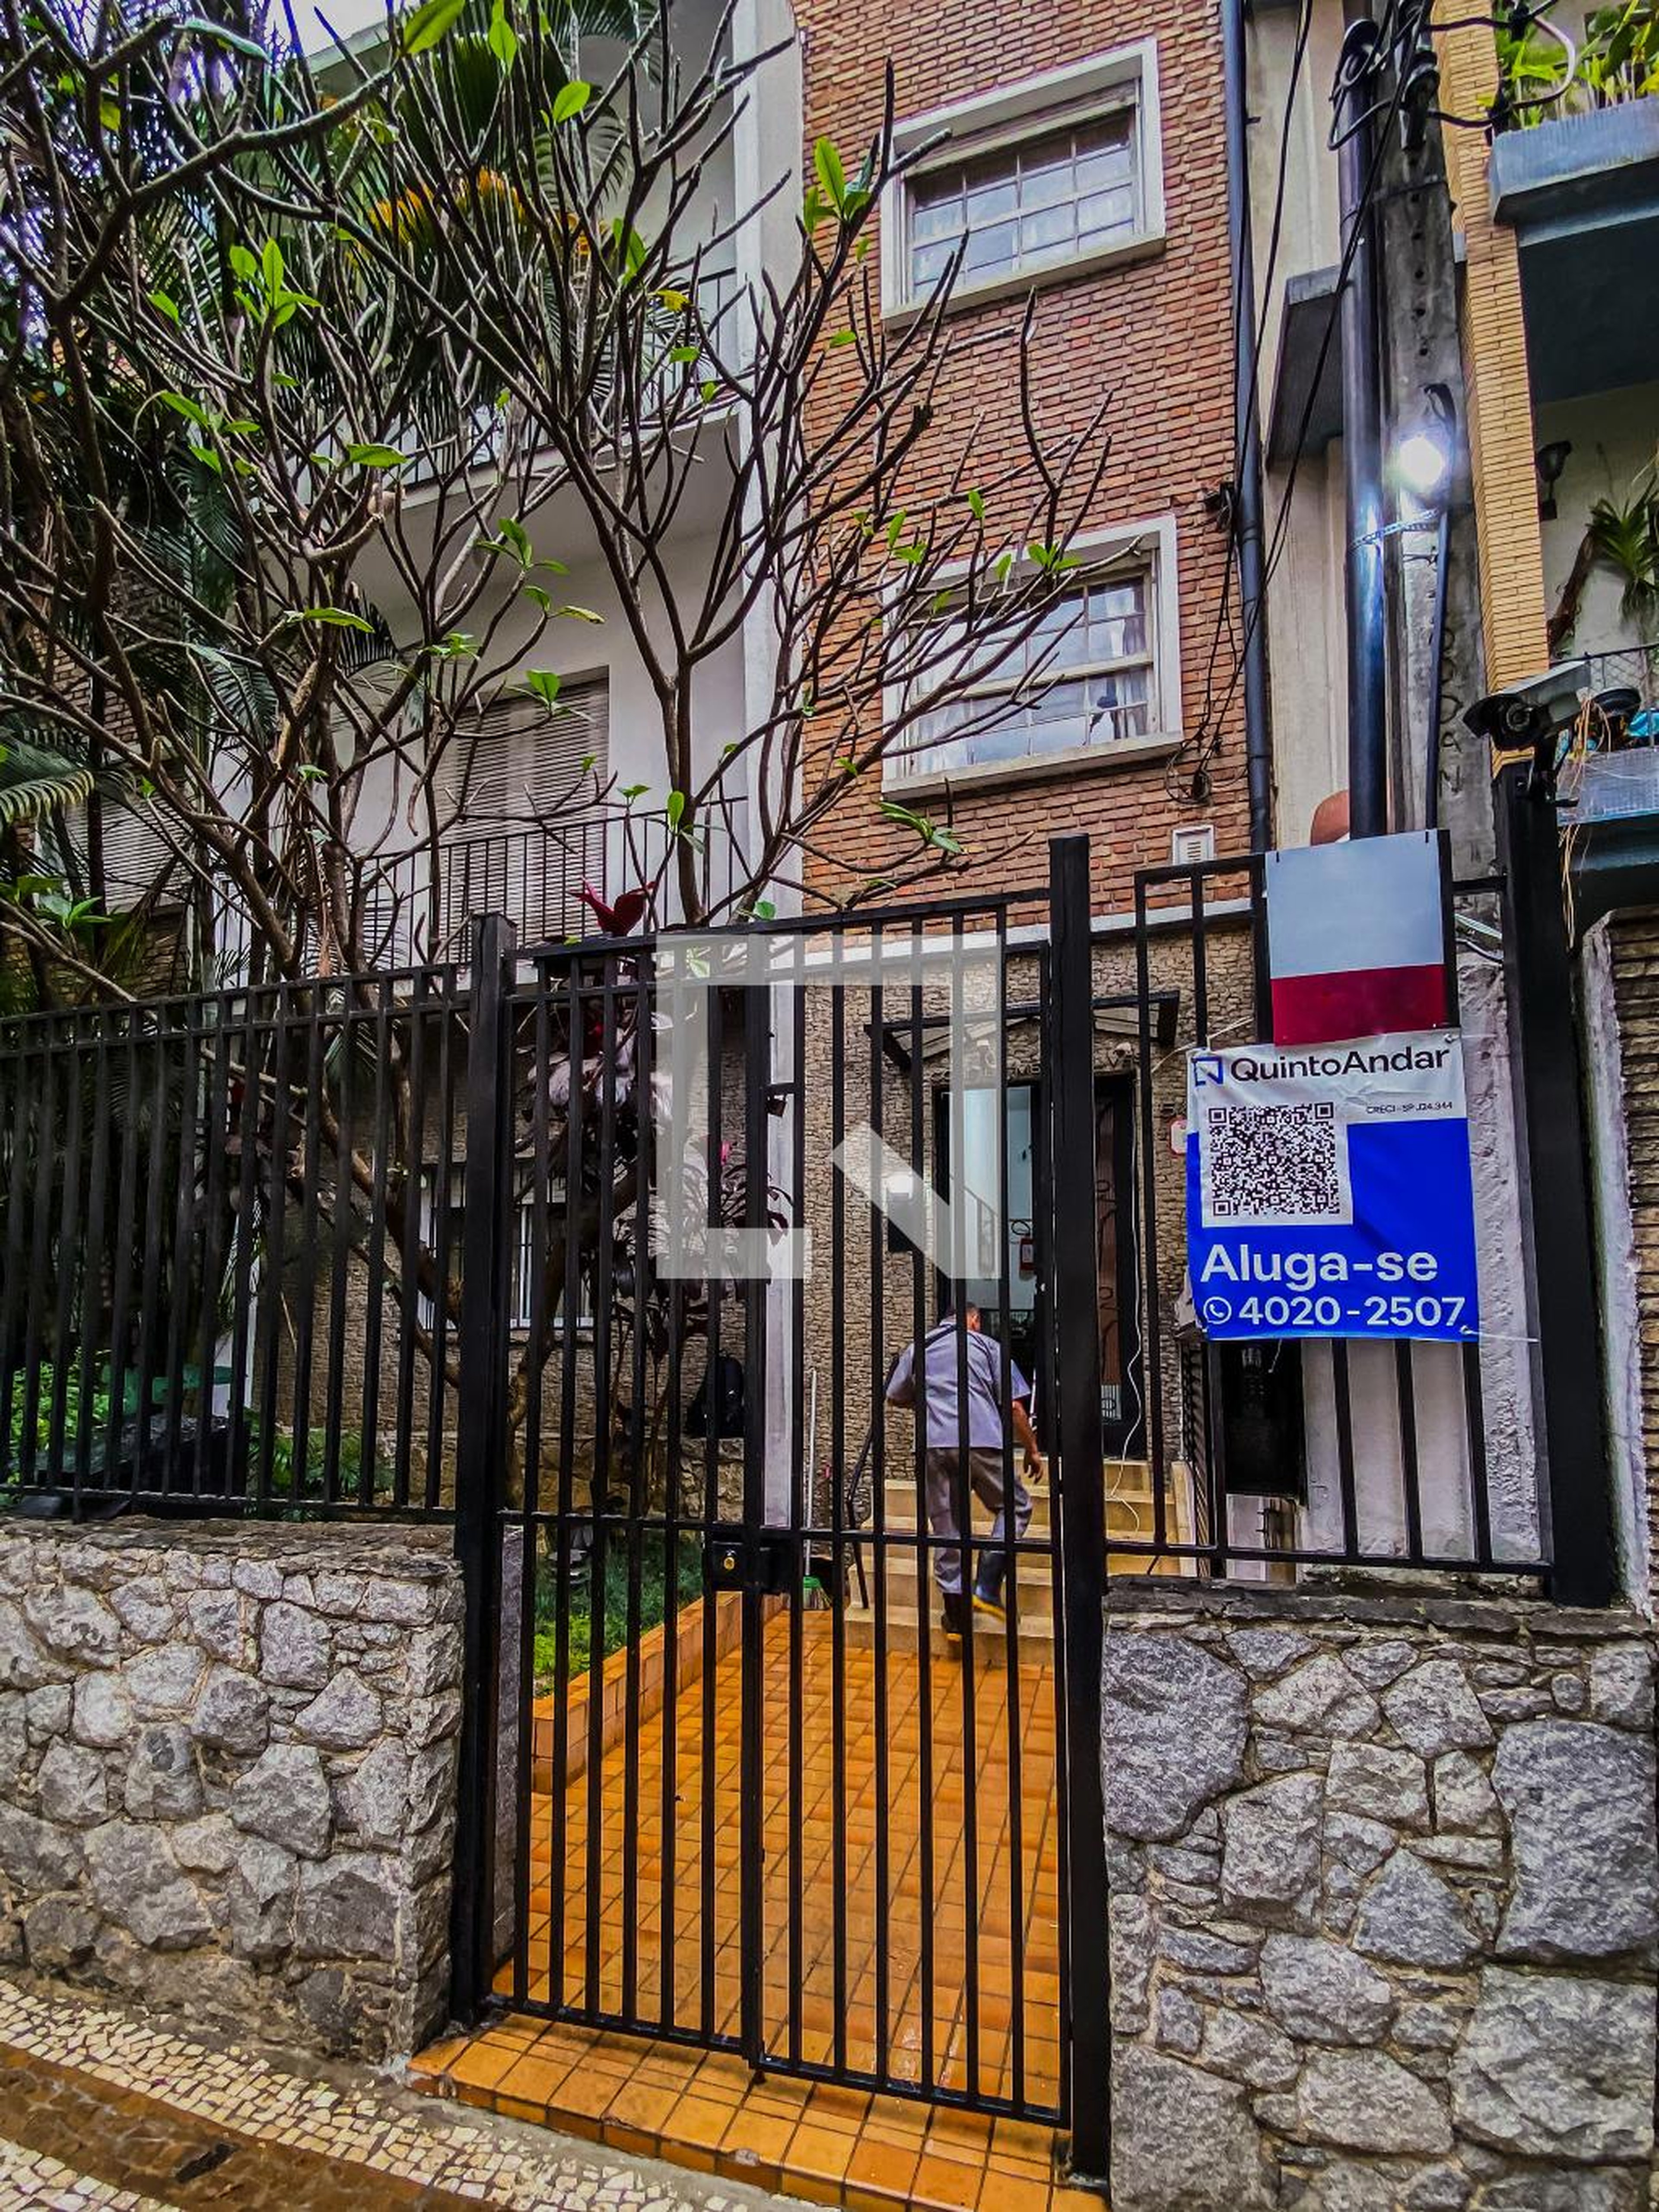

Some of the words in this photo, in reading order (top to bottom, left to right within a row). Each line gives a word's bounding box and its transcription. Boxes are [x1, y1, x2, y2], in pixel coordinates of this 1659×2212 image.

[1231, 1046, 1450, 1082] QuintoAndar
[1200, 1244, 1438, 1291] Aluga-se
[1238, 1296, 1465, 1326] 4020-2507
